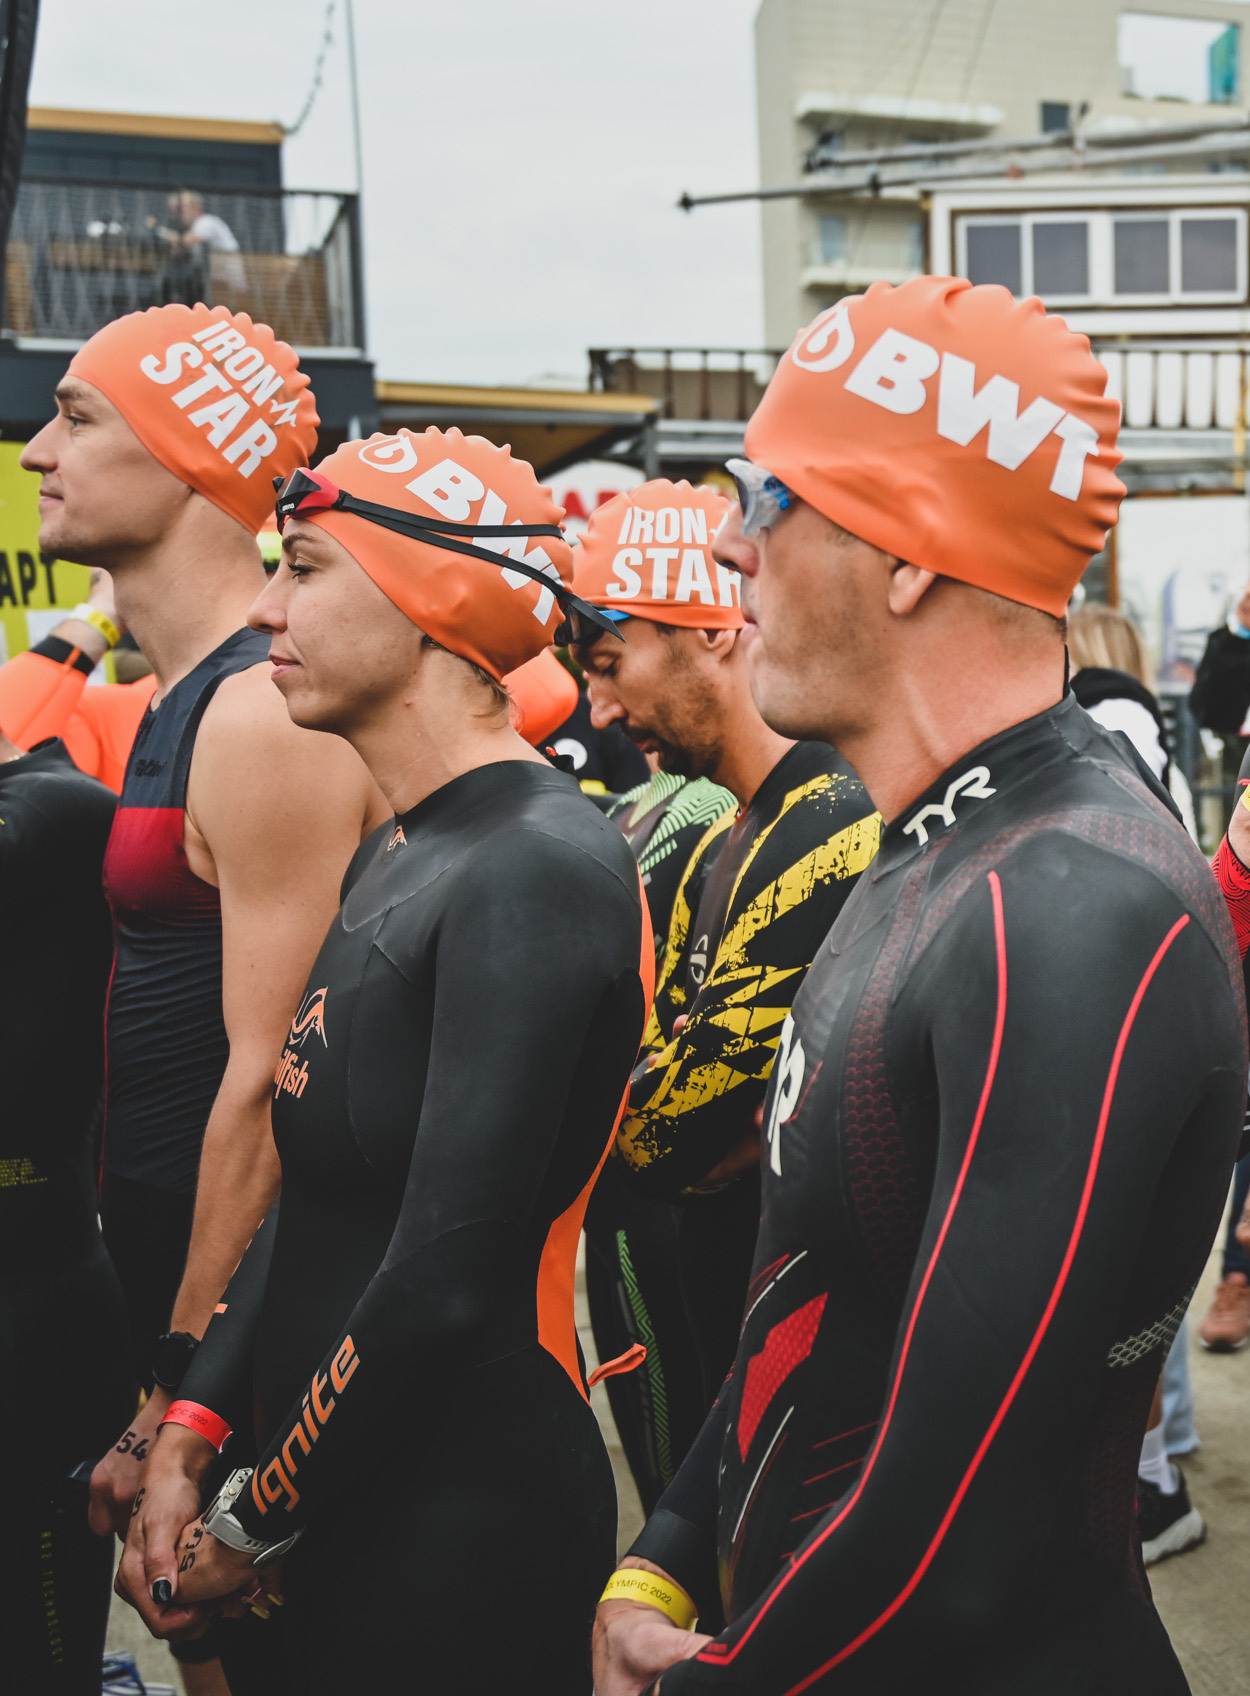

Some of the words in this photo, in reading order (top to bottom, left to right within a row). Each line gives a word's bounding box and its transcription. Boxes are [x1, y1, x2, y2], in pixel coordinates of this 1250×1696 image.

[191, 319, 285, 407] IRON
[140, 341, 278, 479] STAR
[843, 327, 1100, 502] BWT
[617, 505, 708, 545] IRON
[902, 765, 998, 847] TYR
[649, 1586, 672, 1606] 2022
